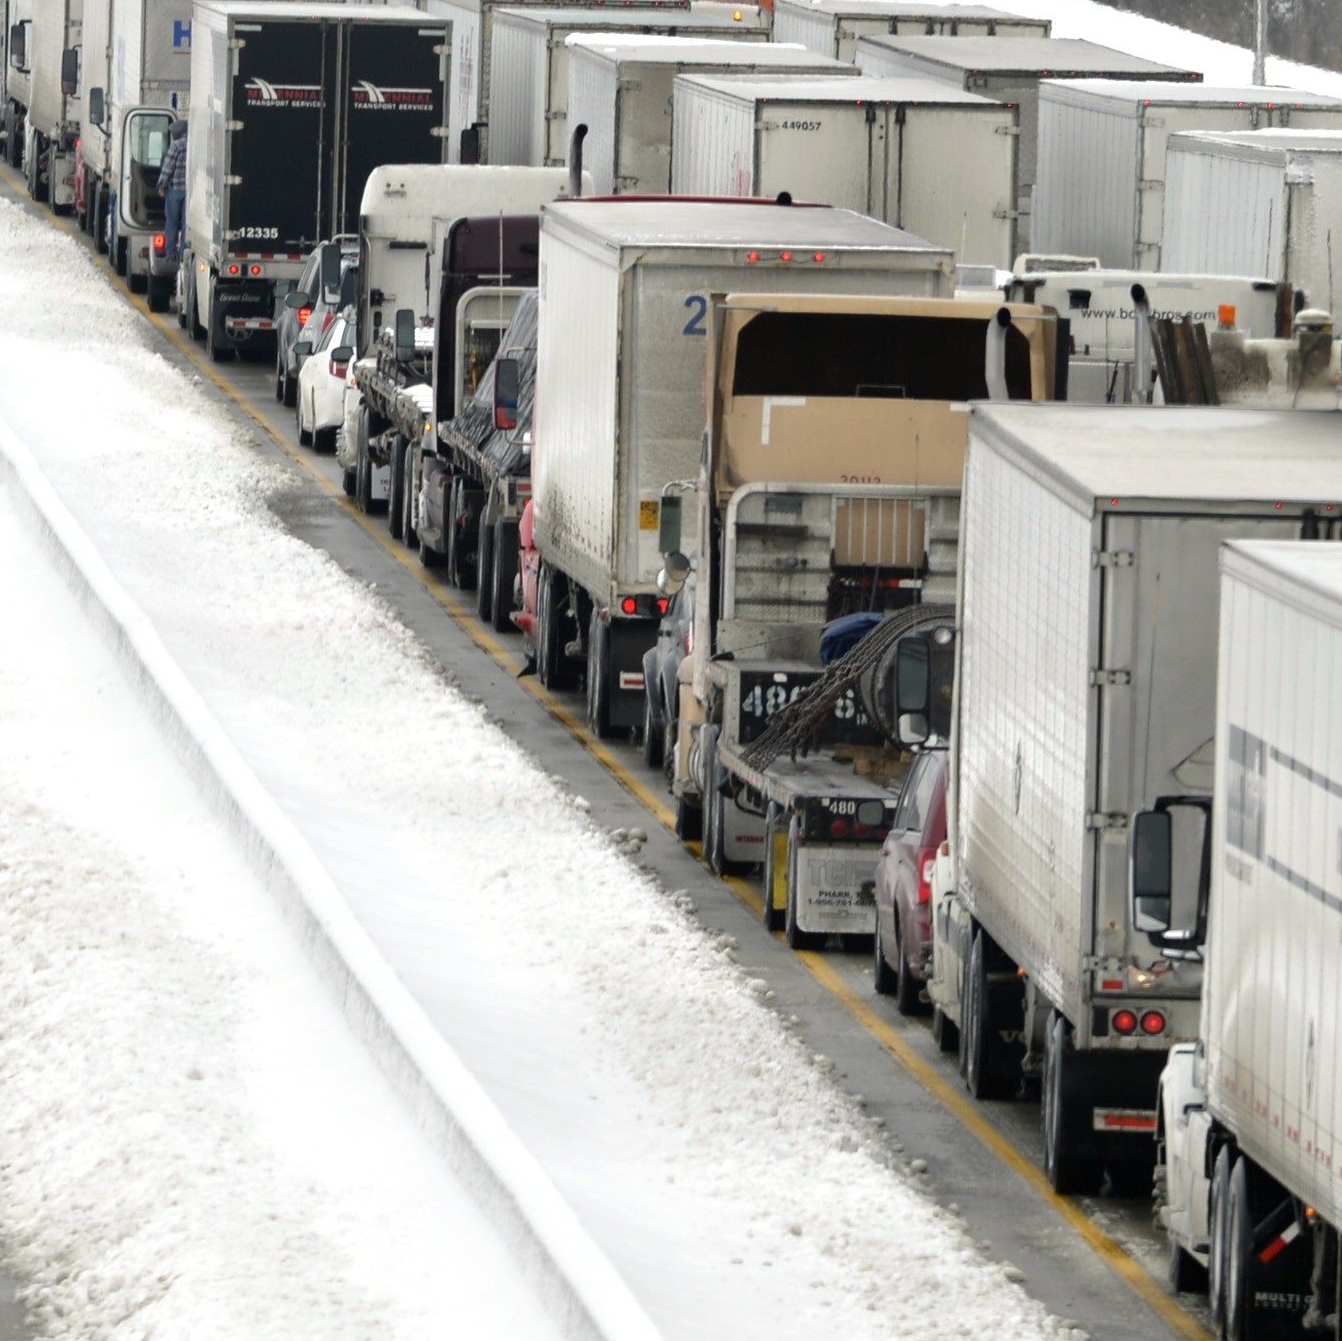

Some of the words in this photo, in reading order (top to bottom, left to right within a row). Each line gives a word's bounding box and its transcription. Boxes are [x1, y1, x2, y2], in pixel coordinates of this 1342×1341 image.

[247, 99, 290, 108] TRANSPORT
[354, 102, 397, 111] TRANSPORT
[398, 103, 433, 111] SERVICES
[781, 121, 822, 131] 449057
[239, 226, 279, 239] 12335
[1081, 307, 1216, 321] www.bobros.com
